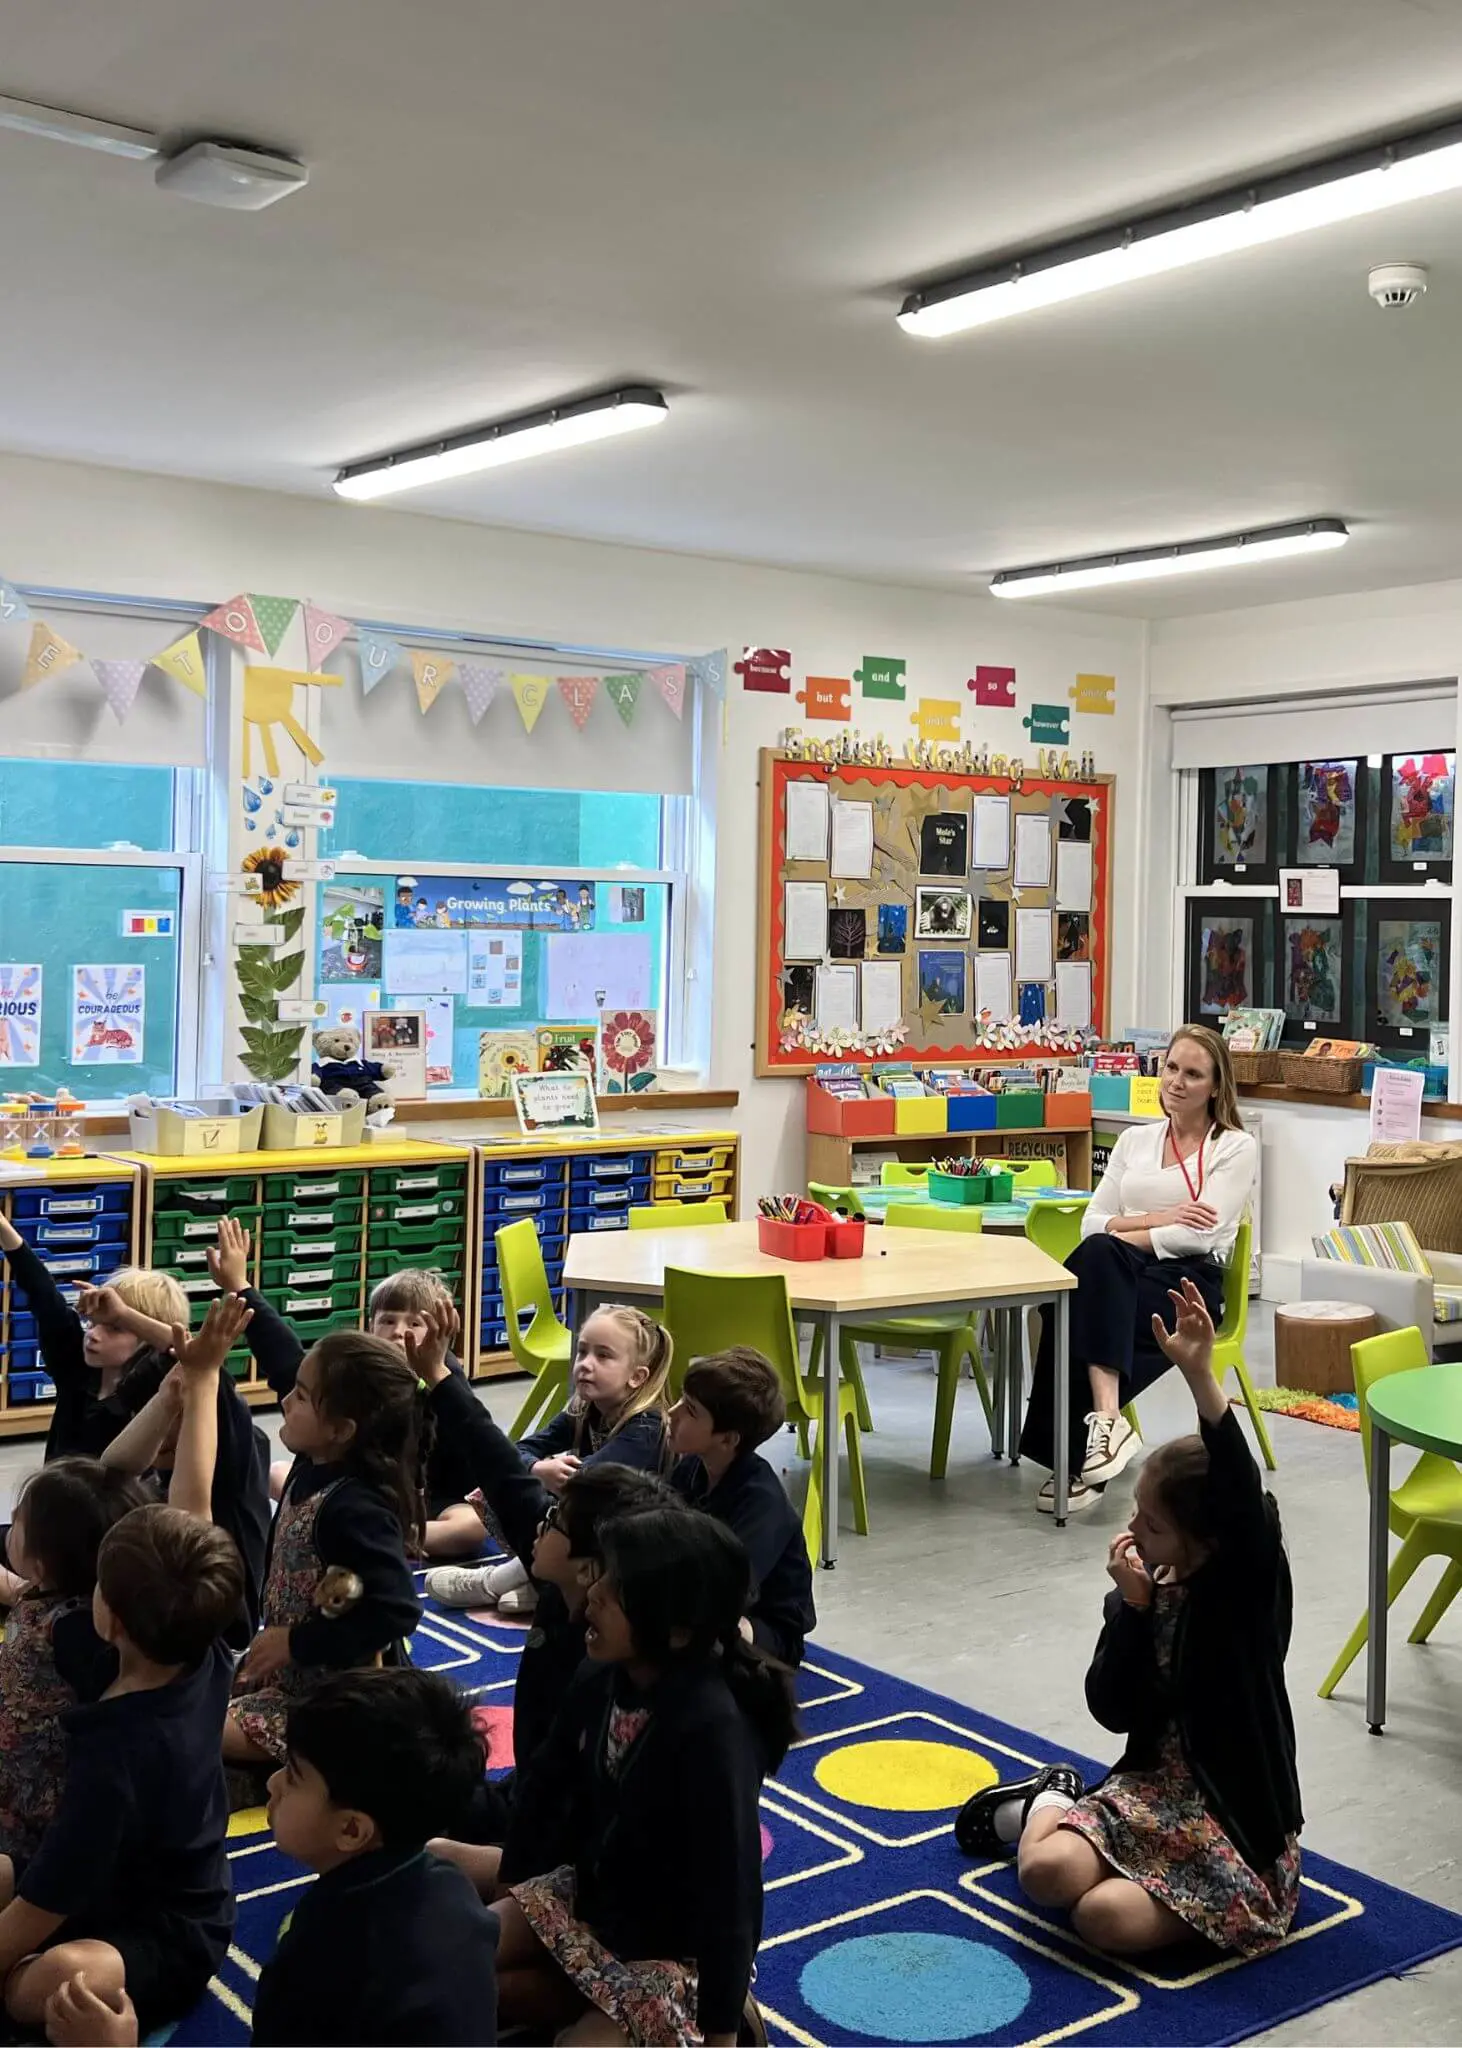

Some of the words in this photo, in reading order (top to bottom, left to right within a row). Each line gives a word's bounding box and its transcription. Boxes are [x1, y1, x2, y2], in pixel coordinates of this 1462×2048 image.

[314, 621, 437, 687] OUR
[521, 663, 721, 708] CLASS
[871, 671, 890, 683] and
[987, 682, 998, 691] so
[816, 691, 833, 704] but
[1039, 748, 1097, 784] Wall
[447, 897, 504, 914] Growing
[508, 898, 551, 912] Plants
[105, 987, 119, 1000] be
[0, 1001, 37, 1016] IOUS
[78, 1004, 140, 1014] COURAGEOUS
[554, 1034, 576, 1044] Fruit
[1008, 1142, 1064, 1157] RECYCLING
